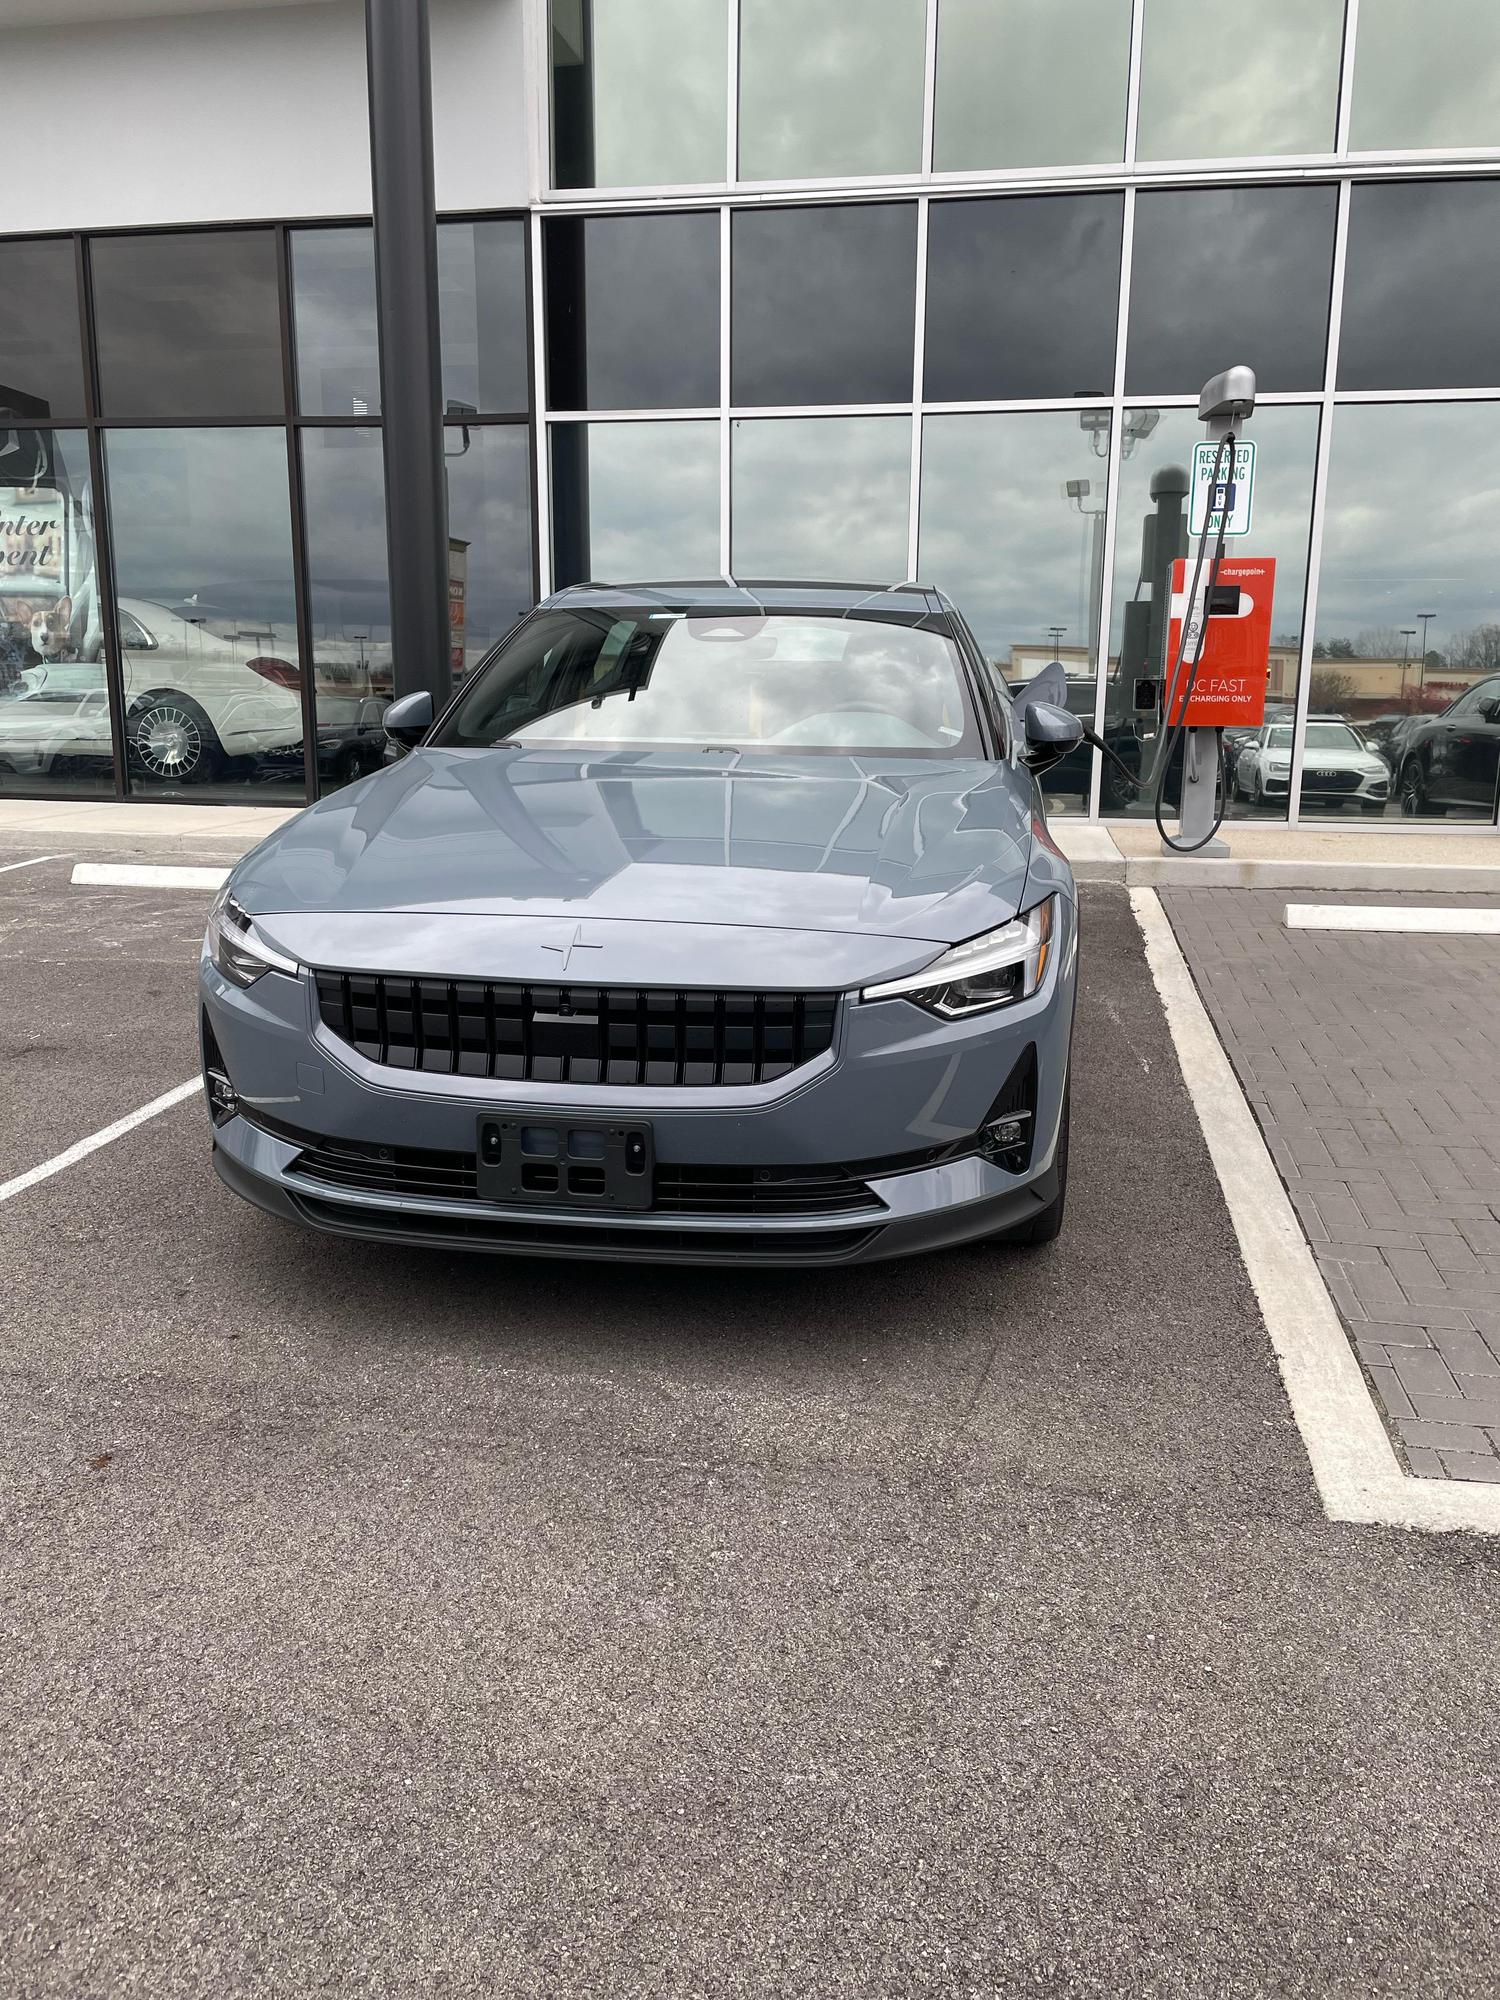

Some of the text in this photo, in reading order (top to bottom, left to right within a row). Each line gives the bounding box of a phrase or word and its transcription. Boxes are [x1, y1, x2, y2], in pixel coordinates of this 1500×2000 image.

[1199, 449, 1250, 464] RESRED
[1208, 514, 1234, 528] ONY
[1221, 567, 1266, 577] chargepoint
[1186, 679, 1247, 692] DC FAST
[1190, 695, 1230, 703] CHARGING
[1231, 695, 1252, 703] ONLY
